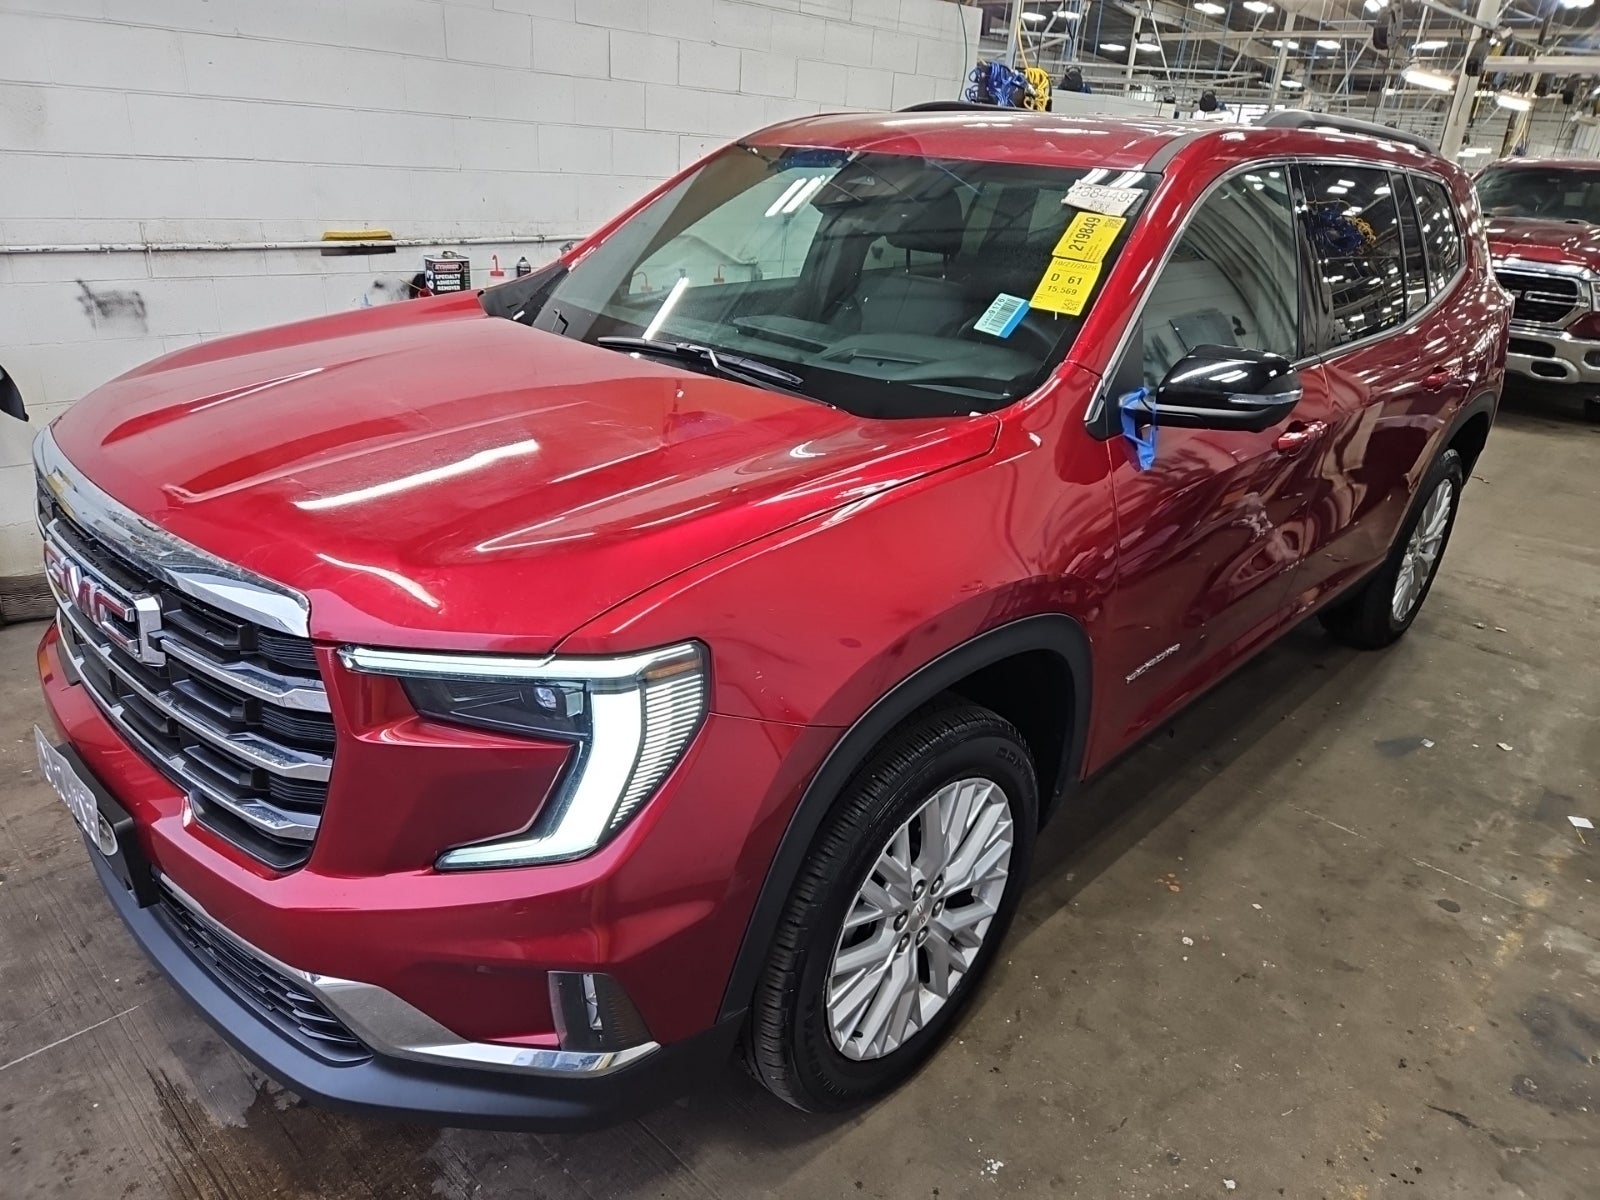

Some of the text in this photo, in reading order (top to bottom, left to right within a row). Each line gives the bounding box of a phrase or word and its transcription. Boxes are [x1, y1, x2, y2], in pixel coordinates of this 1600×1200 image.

[1068, 217, 1101, 252] 219849
[1051, 273, 1082, 285] D 61
